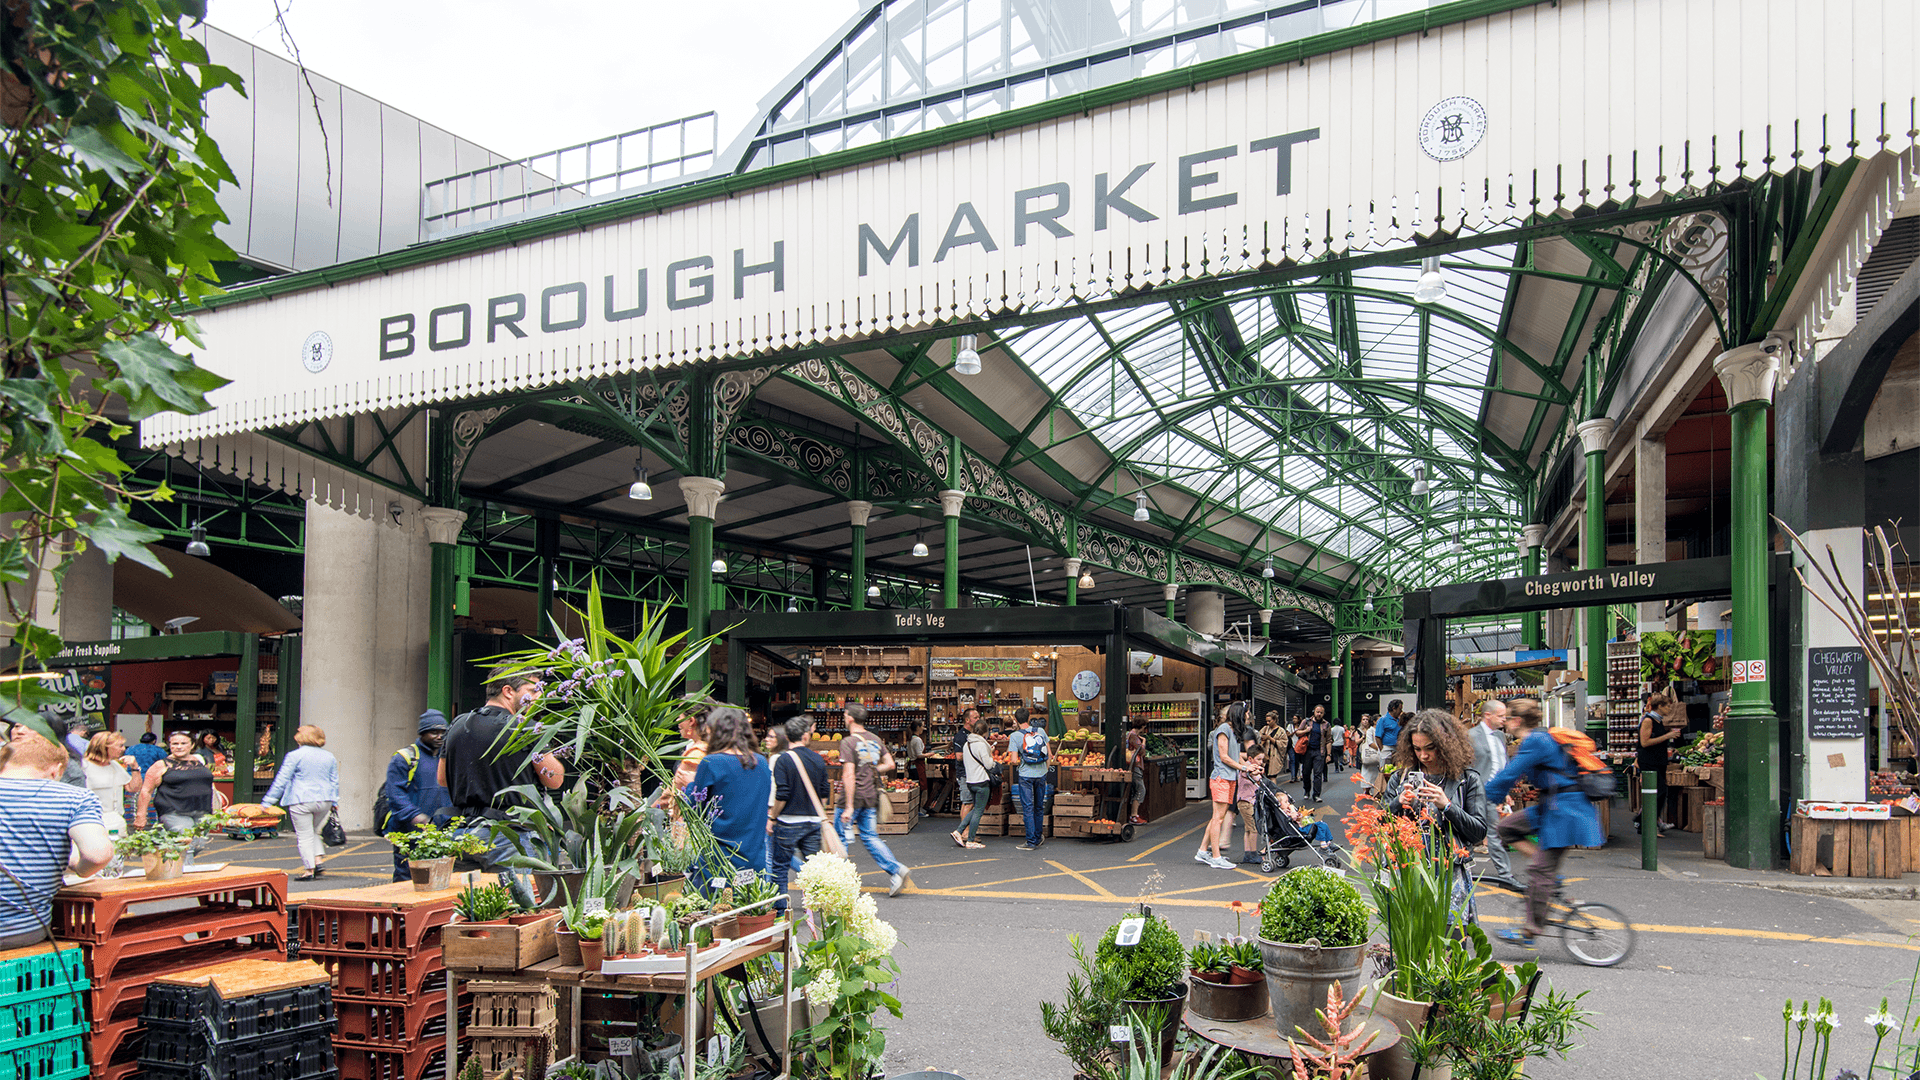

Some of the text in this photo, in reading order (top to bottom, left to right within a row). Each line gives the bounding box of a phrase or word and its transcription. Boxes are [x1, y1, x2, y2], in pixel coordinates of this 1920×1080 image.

[1422, 100, 1457, 143] BOROUGH
[1461, 100, 1483, 133] MARKET
[379, 127, 1320, 361] BOROUGH MARKET
[1525, 570, 1656, 596] Chegworth Valley
[895, 613, 945, 628] Ted's Veg
[75, 645, 92, 657] Fresh
[93, 643, 121, 657] Supplies
[1813, 651, 1863, 665] CHEGWORTH
[997, 660, 1021, 672] VEG
[1825, 664, 1853, 676] VALLEY
[37, 669, 80, 693] aul
